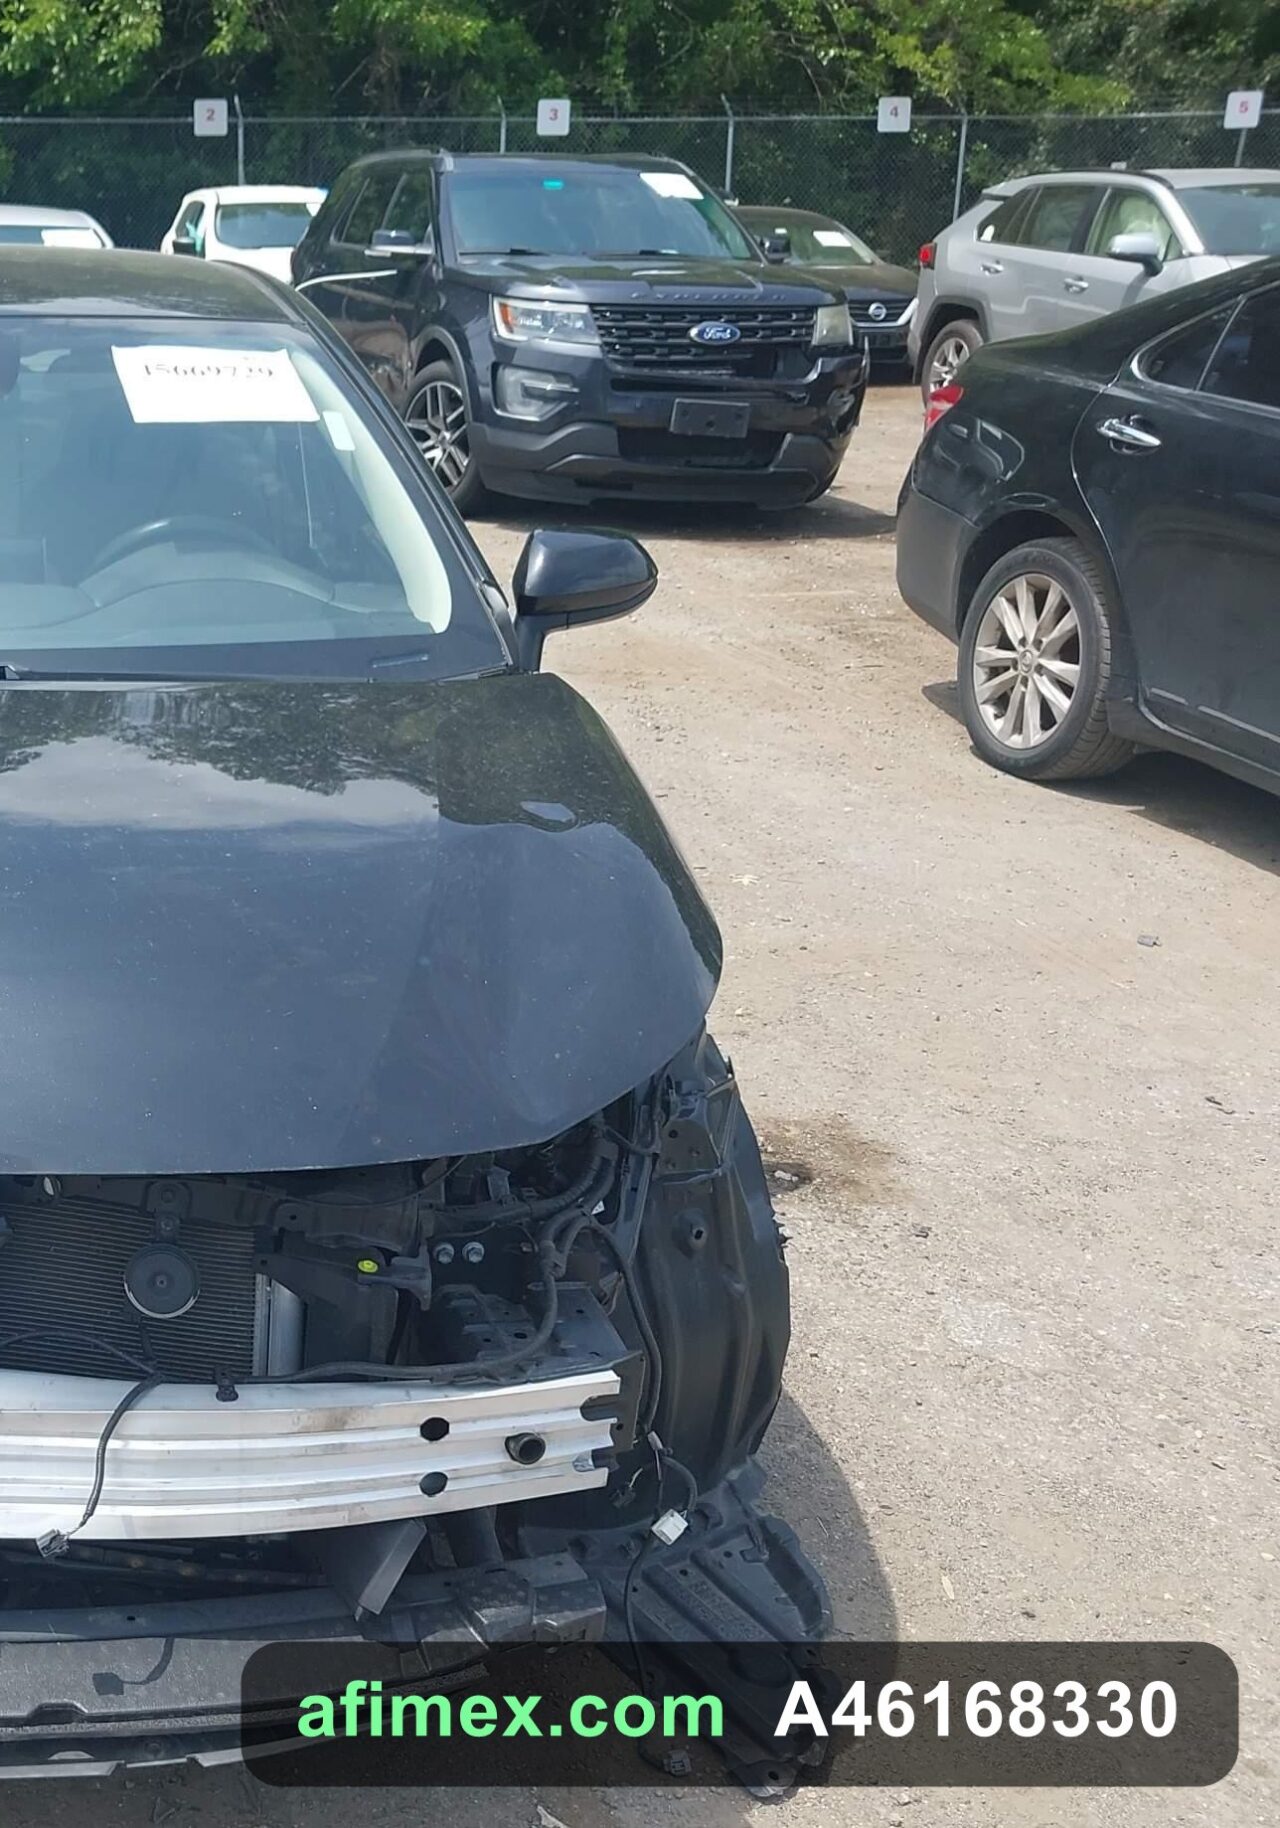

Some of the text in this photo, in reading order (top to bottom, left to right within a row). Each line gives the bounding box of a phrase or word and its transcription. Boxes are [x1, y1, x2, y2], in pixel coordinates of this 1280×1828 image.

[205, 108, 216, 121] 2
[549, 108, 559, 121] 3
[889, 105, 899, 118] 4
[703, 327, 732, 340] Ford
